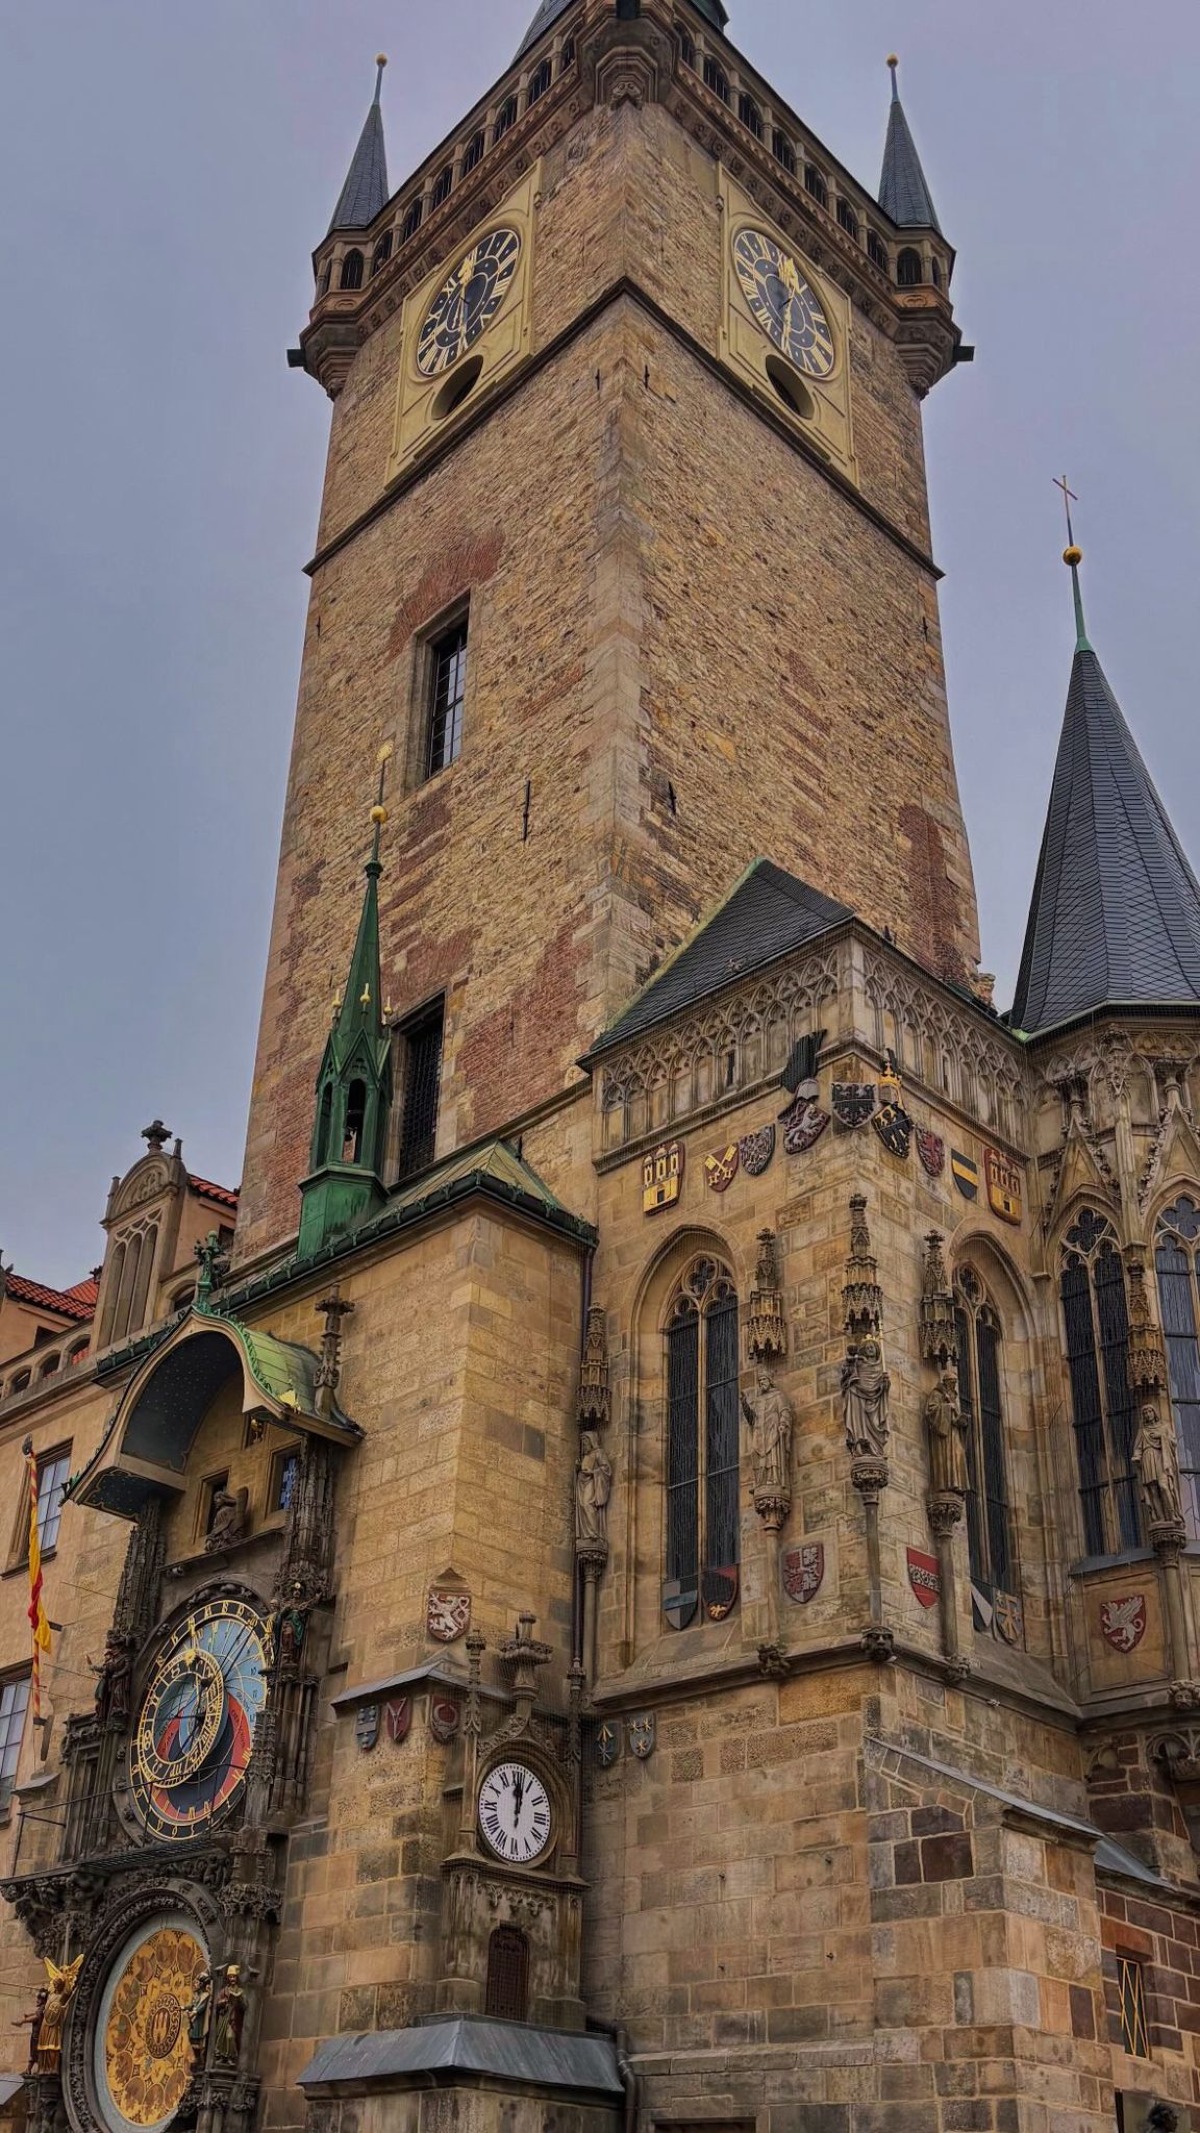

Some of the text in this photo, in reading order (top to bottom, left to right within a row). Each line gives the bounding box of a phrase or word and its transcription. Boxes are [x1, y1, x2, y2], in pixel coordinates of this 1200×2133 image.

[488, 1783, 502, 1798] X
[531, 1796, 544, 1807] II
[534, 1812, 547, 1826] III
